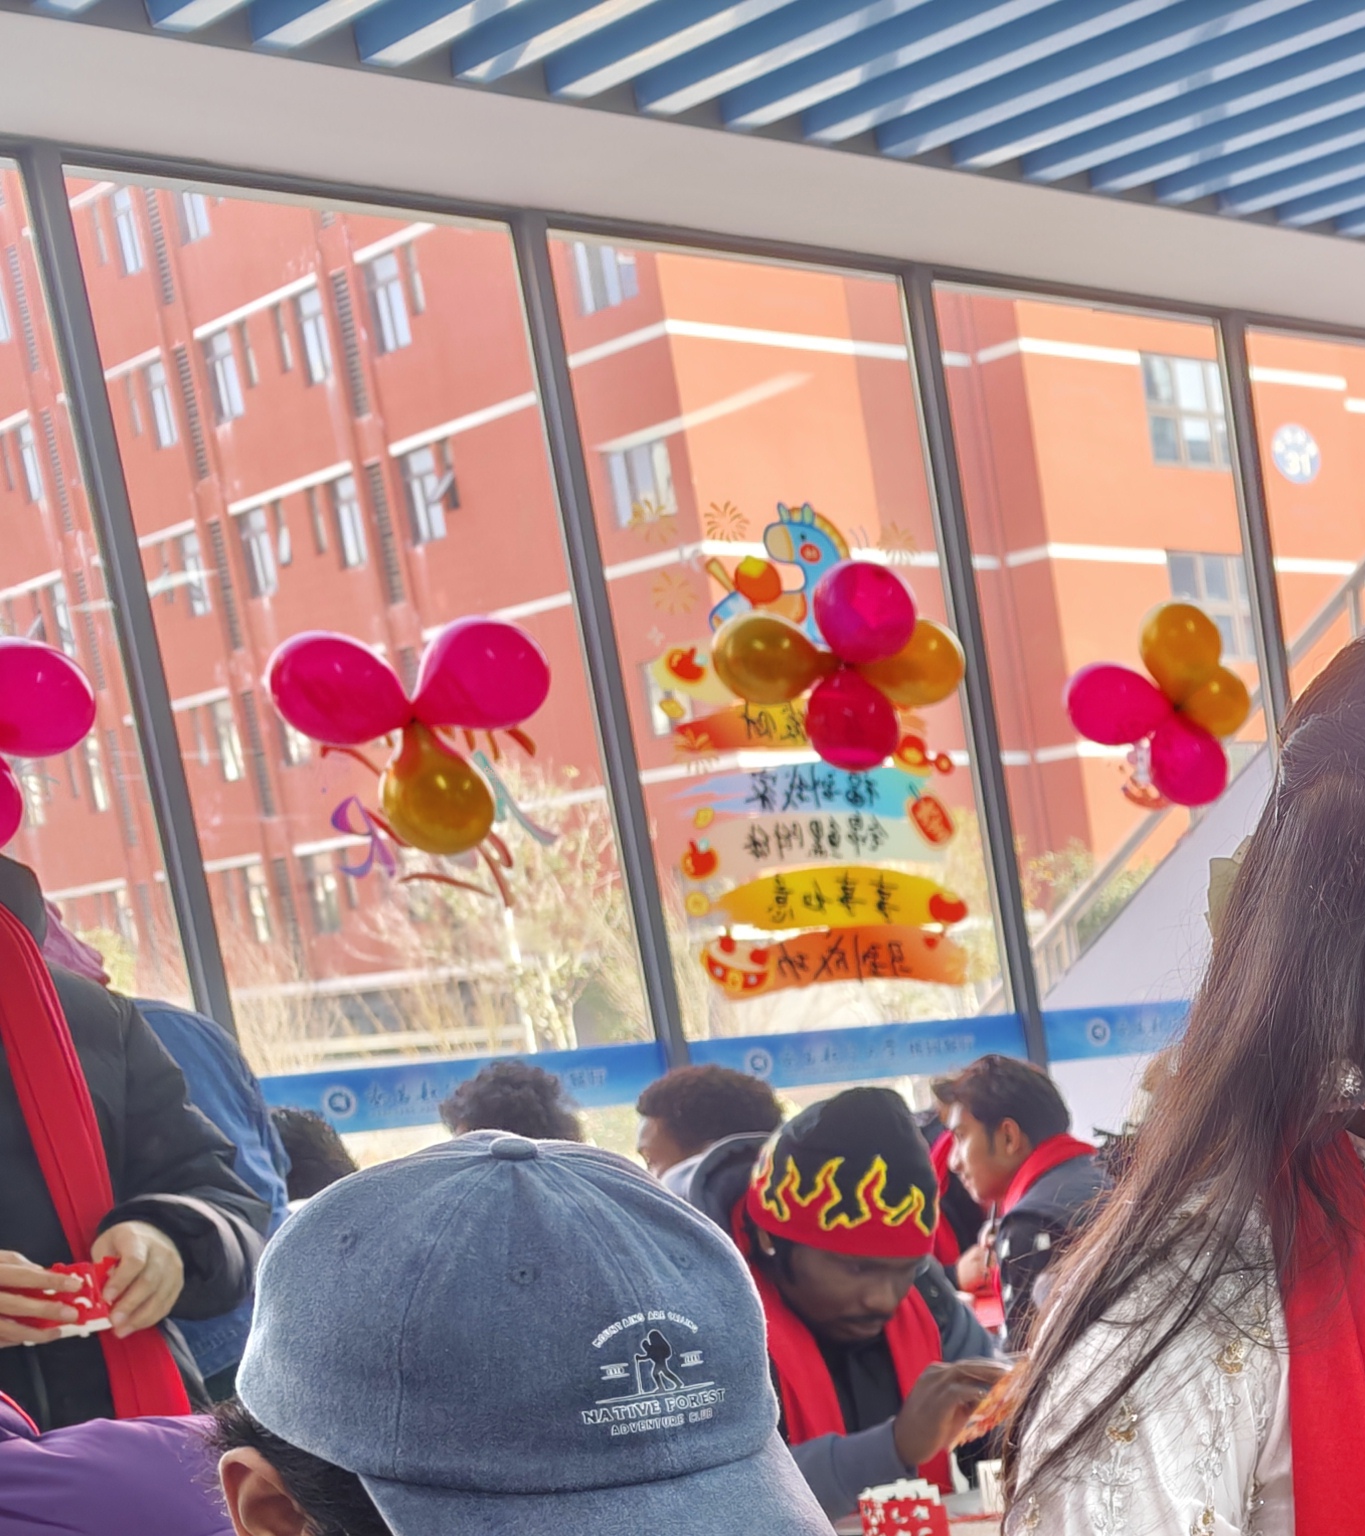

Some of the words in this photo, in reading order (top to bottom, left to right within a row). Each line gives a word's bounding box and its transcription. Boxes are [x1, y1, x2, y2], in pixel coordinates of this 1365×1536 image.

[582, 1400, 661, 1425] NATIVE
[665, 1388, 726, 1413] FOREST
[611, 1414, 685, 1436] ADVENTURE
[688, 1408, 713, 1423] CLUB
